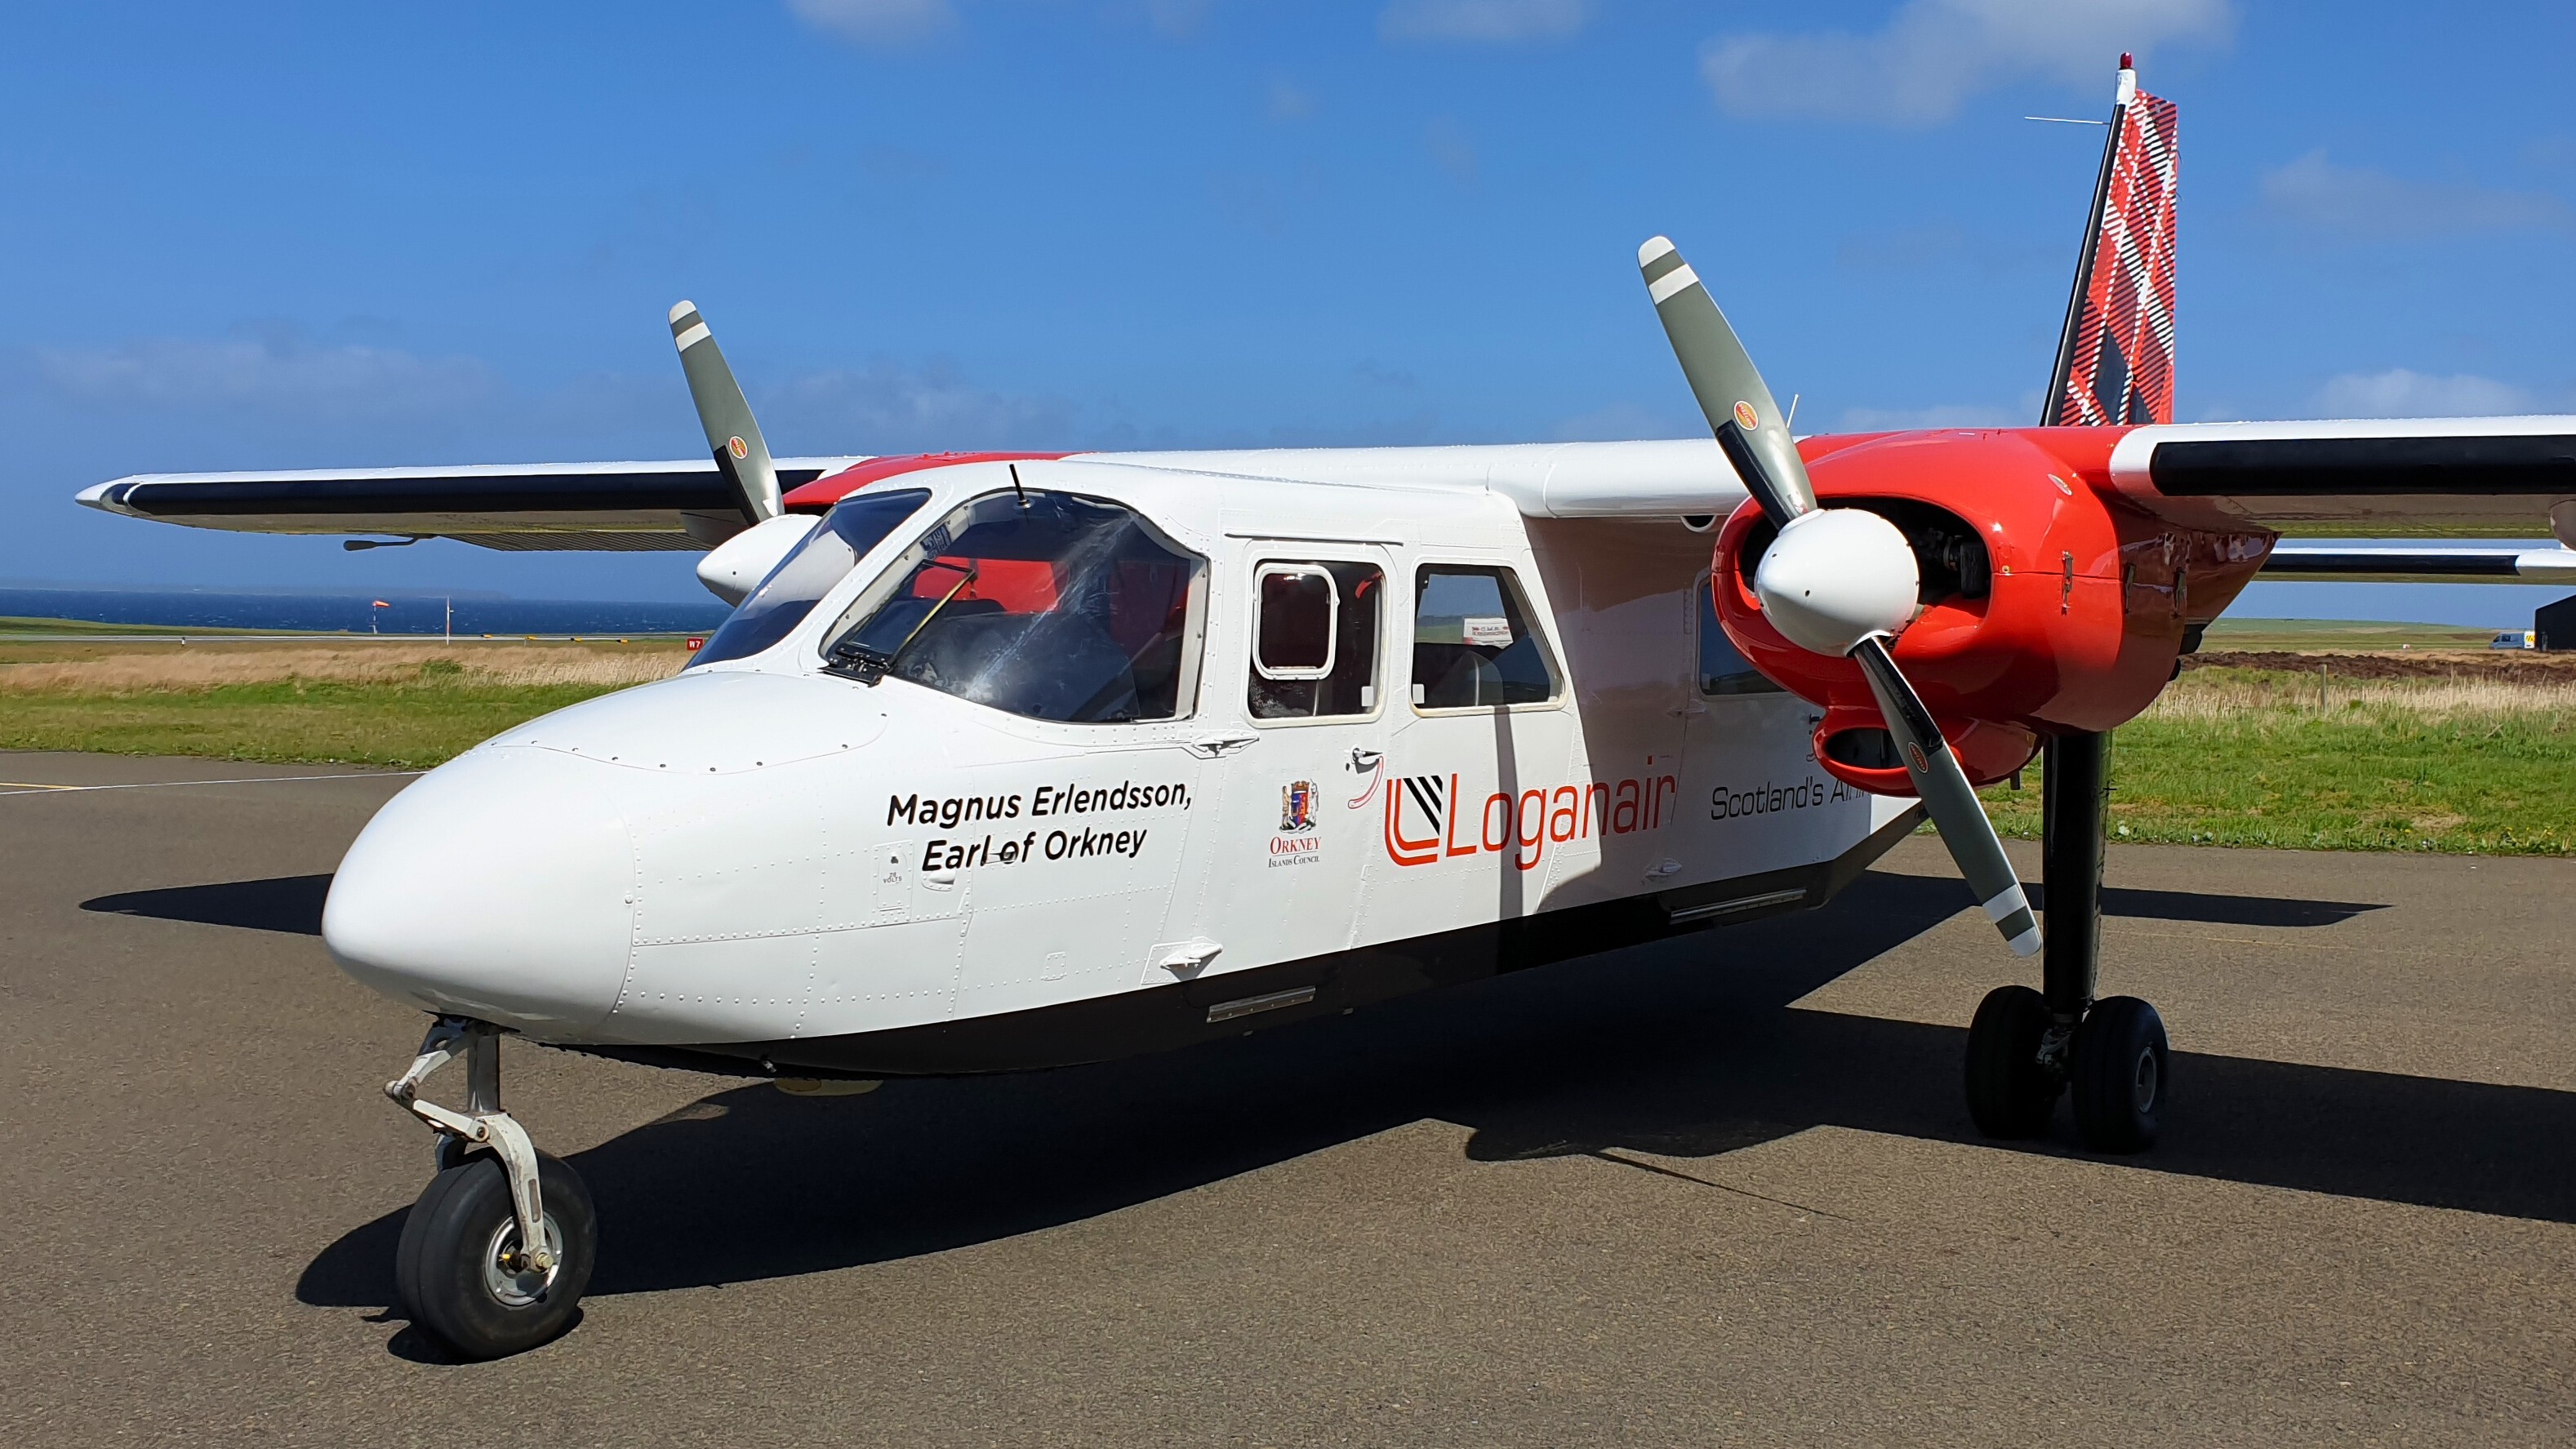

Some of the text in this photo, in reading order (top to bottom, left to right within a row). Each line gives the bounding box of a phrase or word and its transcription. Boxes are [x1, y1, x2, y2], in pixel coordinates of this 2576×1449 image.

[887, 780, 1191, 829] Magnus Erlendsson,
[1445, 756, 1675, 872] Loganair
[1711, 776, 1824, 820] Scotland's
[922, 826, 1147, 872] Earl of Orkney
[1270, 836, 1321, 855] ORKNEY
